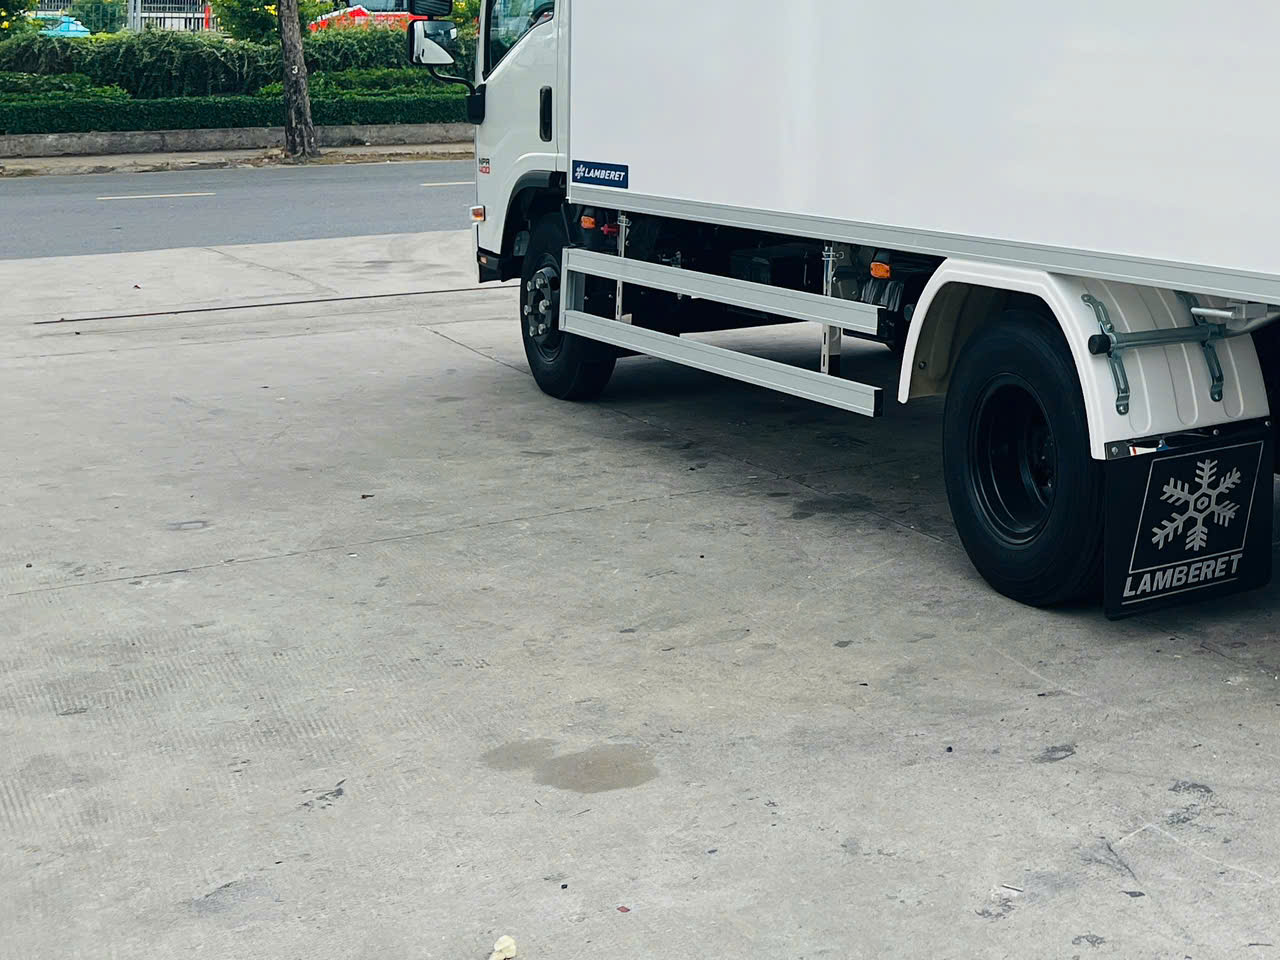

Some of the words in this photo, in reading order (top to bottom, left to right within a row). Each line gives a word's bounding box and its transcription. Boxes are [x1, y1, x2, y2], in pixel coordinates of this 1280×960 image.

[291, 65, 298, 74] 3
[584, 167, 626, 182] LAMBERET
[1122, 553, 1243, 598] LAMBERET
